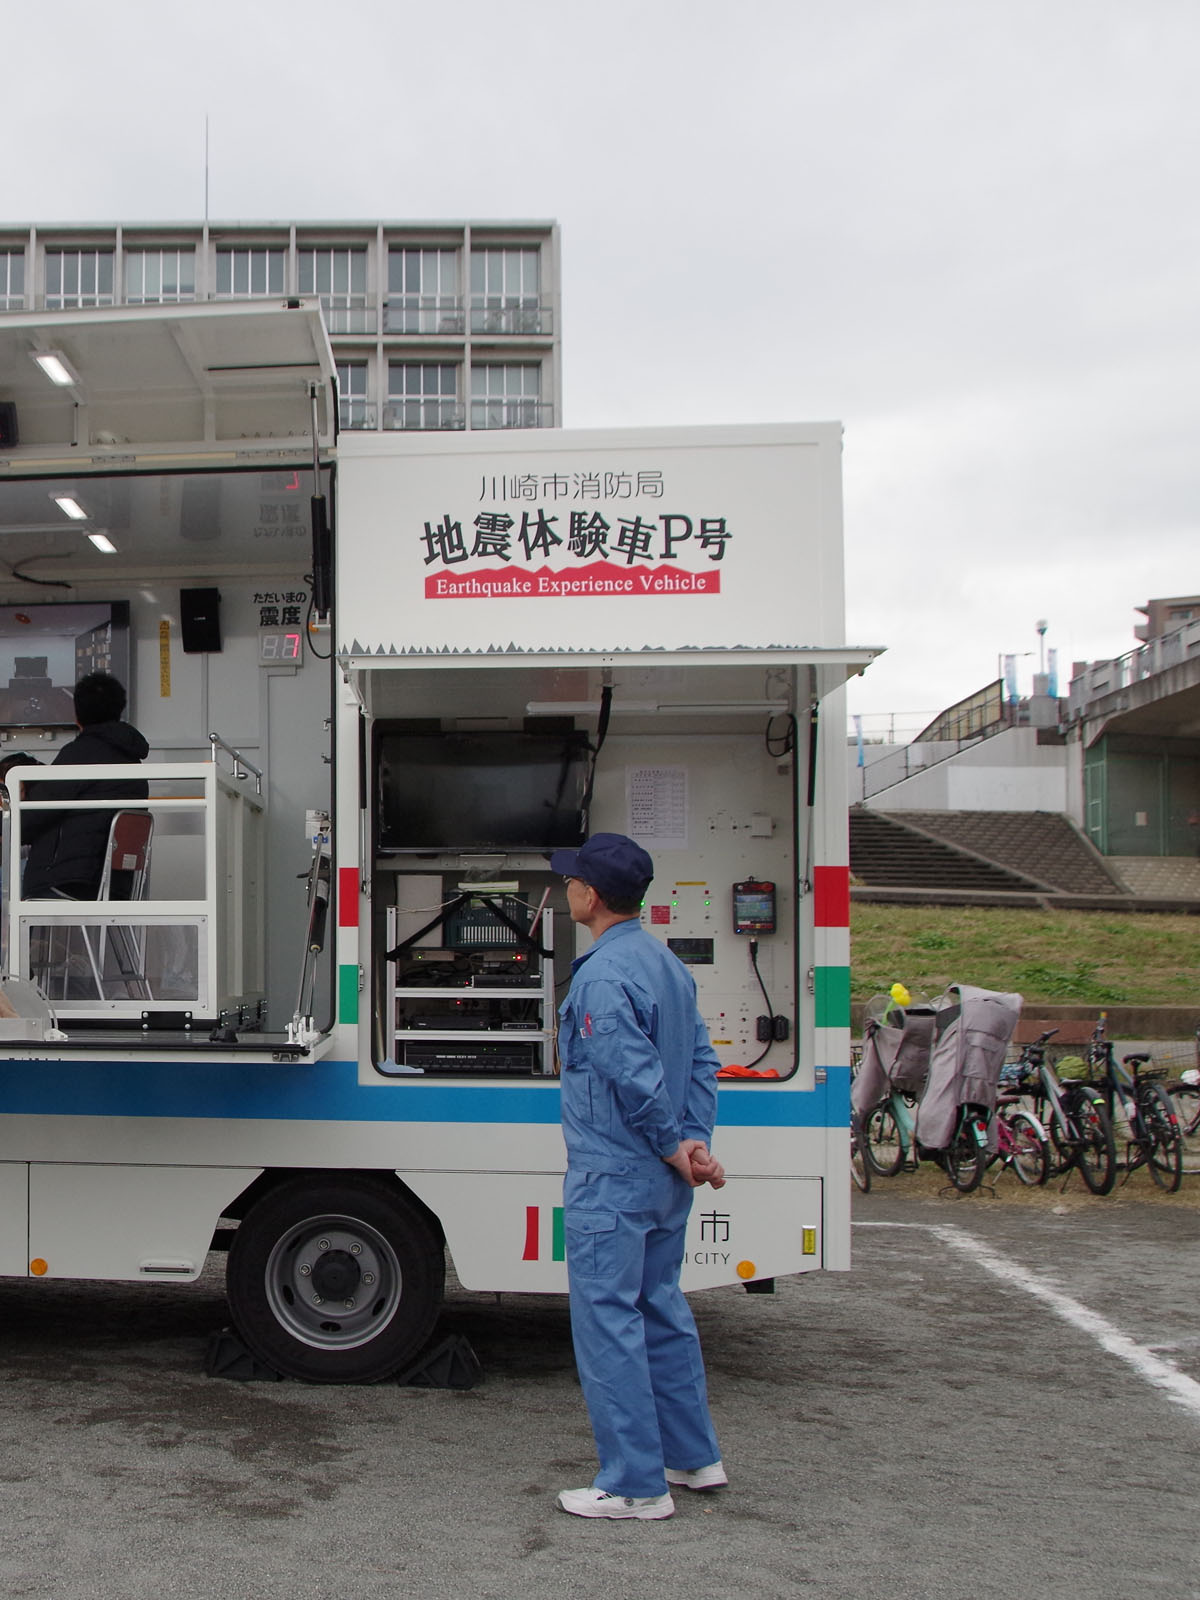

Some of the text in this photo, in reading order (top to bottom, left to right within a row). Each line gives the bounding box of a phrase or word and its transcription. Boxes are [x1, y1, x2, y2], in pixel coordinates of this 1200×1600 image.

[479, 471, 664, 501] 川崎市消防局
[419, 508, 733, 566] 地震体験車P号
[436, 574, 706, 597] Earthquake Experience Vehicle
[253, 591, 307, 604] ただいまの
[259, 605, 301, 627] 震度
[694, 1252, 730, 1265] CITY
